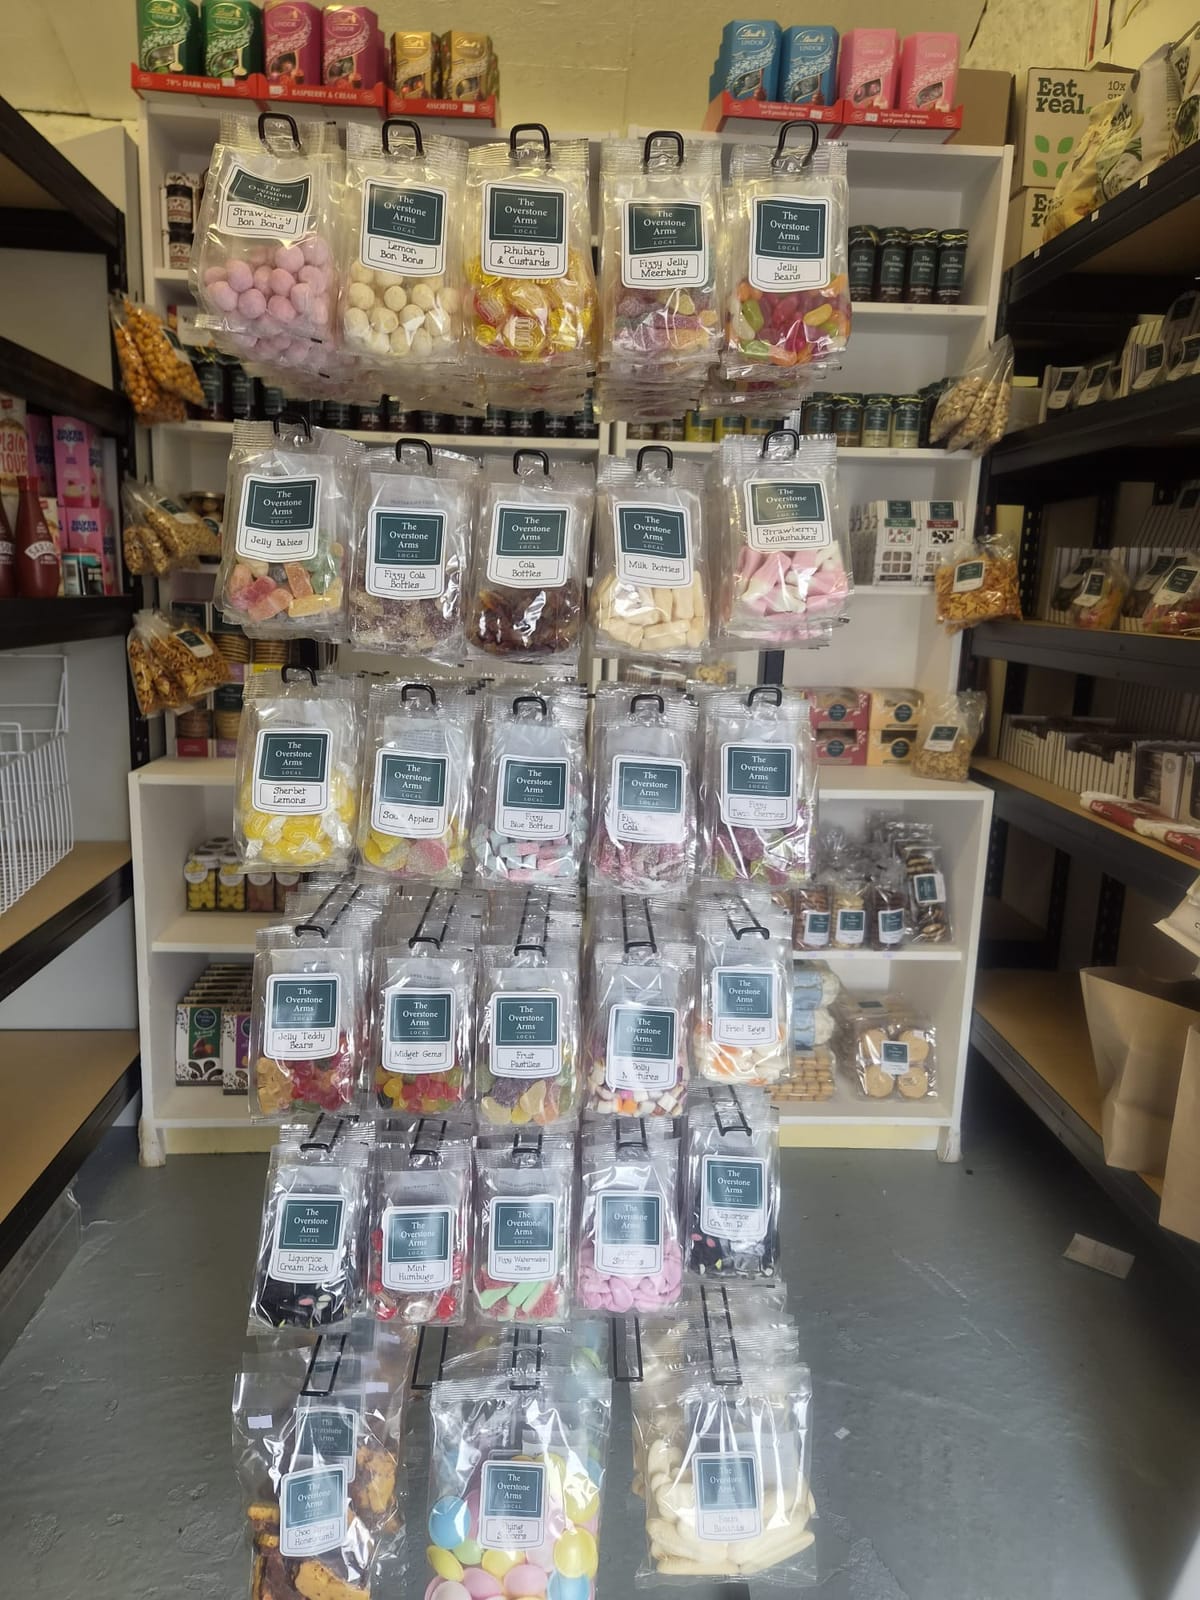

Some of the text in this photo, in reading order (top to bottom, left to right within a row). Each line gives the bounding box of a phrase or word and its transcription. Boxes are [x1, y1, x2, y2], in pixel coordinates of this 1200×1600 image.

[1037, 77, 1078, 97] Eat
[1108, 80, 1126, 91] 10x
[1035, 94, 1085, 115] real
[248, 185, 292, 199] Overstone
[263, 184, 281, 192] The
[256, 191, 280, 202] Arms
[398, 194, 414, 204] The
[518, 198, 535, 207] The
[384, 201, 426, 217] Overstone
[504, 206, 548, 216] Overstone
[393, 212, 416, 224] Arms
[656, 210, 673, 218] The
[782, 211, 798, 221] The
[237, 218, 284, 229] Bon Bons
[514, 216, 537, 225] Arms
[643, 219, 686, 227] Overstone
[770, 220, 809, 231] Overstone
[653, 227, 676, 235] Arms
[779, 232, 800, 241] Arms
[388, 241, 417, 254] Lemon
[504, 246, 545, 256] Rhubarb
[380, 250, 423, 265] Bon Bons
[497, 256, 550, 267] & Custards
[639, 258, 688, 270] Fizzy Jelly
[777, 262, 798, 273] Jelly
[641, 268, 686, 278] Meerkats
[774, 273, 800, 281] Beans
[766, 495, 807, 503] Overstone
[776, 502, 798, 510] Arms
[524, 516, 540, 524] The
[644, 516, 660, 524] The
[401, 522, 417, 531] The
[633, 524, 671, 534] Overstone
[762, 526, 818, 536] Strawberry
[389, 531, 428, 540] Overstone
[520, 533, 541, 541] Arms
[643, 533, 663, 541] Arms
[765, 534, 817, 543] Milkshakes
[251, 536, 303, 548] Jelly Babies
[398, 541, 419, 549] Arms
[518, 561, 535, 569] Cola
[628, 560, 680, 573] Milk Bottles
[384, 570, 426, 581] Fizzy Cola
[512, 569, 541, 577] Bottles
[391, 581, 420, 589] Bottles
[275, 750, 312, 758] Overstone
[407, 764, 421, 772] The
[740, 764, 778, 772] Overstone
[394, 772, 431, 783] Overstone
[528, 769, 542, 777] The
[402, 782, 422, 790] Arms
[516, 777, 552, 786] Overstone
[631, 779, 668, 789] Overstone
[273, 787, 306, 795] Sherbet
[273, 796, 306, 804] Lemons
[408, 814, 434, 824] Apples
[510, 821, 553, 830] Blue Bottles
[623, 823, 638, 831] Cola
[738, 979, 751, 987] The
[736, 996, 752, 1004] Arms
[508, 1014, 544, 1022] Overstone
[638, 1018, 651, 1026] The
[626, 1027, 661, 1035] Overstone
[278, 1032, 325, 1041] Jelly Teddy
[633, 1035, 653, 1043] Arms
[394, 1051, 419, 1060] Midget
[516, 1051, 534, 1059] Fruit
[728, 1170, 740, 1178] The
[718, 1178, 750, 1186] Overstone
[294, 1217, 328, 1225] Overstone
[400, 1230, 434, 1238] Overstone
[288, 1254, 322, 1263] Liquorice
[280, 1263, 329, 1272] Cream Rock
[407, 1264, 427, 1272] Mint
[398, 1273, 434, 1282] Humbugs
[308, 1483, 321, 1491] The
[497, 1482, 530, 1491] Overstone
[297, 1489, 332, 1502] Overstone
[504, 1492, 522, 1500] Arms
[305, 1500, 323, 1509] Arms
